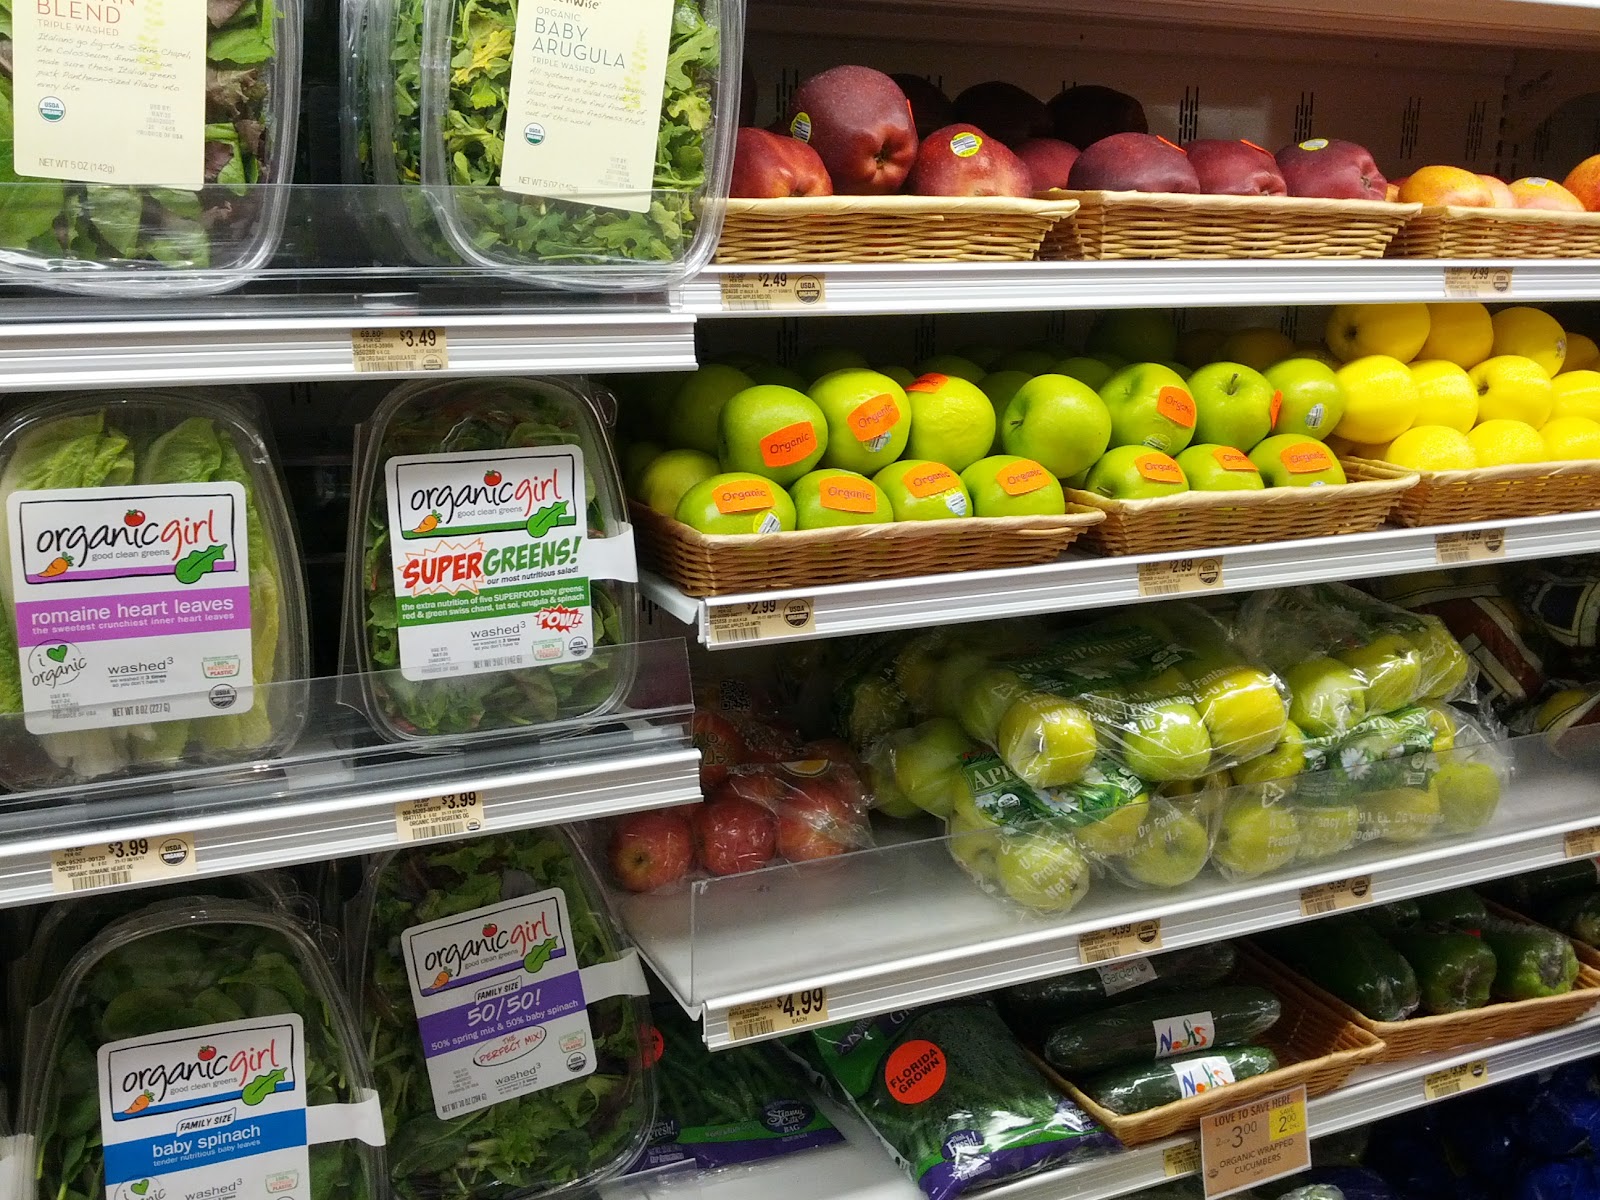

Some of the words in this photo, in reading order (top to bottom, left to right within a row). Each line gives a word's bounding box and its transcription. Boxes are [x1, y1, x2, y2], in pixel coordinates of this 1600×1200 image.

[37, 0, 121, 24] BLEND
[536, 6, 581, 22] ORGANIC
[37, 19, 71, 30] TRIPLE
[75, 24, 119, 36] WASHED
[534, 17, 588, 42] BABY
[37, 33, 73, 44] Italians
[76, 39, 88, 48] go
[129, 44, 158, 54] Sistine
[37, 45, 52, 53] the
[532, 36, 625, 69] ARUGULA
[88, 63, 113, 73] these
[117, 66, 147, 76] Italian
[150, 71, 177, 81] greens
[532, 55, 558, 68] TRIPLE
[561, 61, 596, 75] WASHED
[38, 157, 54, 167] NET
[55, 159, 69, 169] WT
[70, 160, 76, 170] 5
[77, 161, 89, 171] OZ
[90, 163, 115, 174] (142g)
[519, 176, 532, 185] NET
[532, 177, 543, 186] WT
[758, 272, 787, 288] $2.49
[400, 329, 436, 347] $3.49
[858, 403, 894, 429] Organic
[770, 432, 810, 455] Organic
[1290, 452, 1327, 465] Organic
[912, 470, 951, 487] Organic
[1007, 468, 1043, 486] Organic
[410, 468, 562, 524] organicgirl
[722, 488, 767, 502] Organic
[828, 486, 872, 501] Organic
[457, 510, 476, 519] good
[477, 507, 497, 516] clean
[499, 505, 523, 516] greens
[36, 509, 218, 568] organicgirl
[91, 552, 113, 562] good
[115, 551, 139, 560] clean
[141, 549, 170, 560] greens
[402, 551, 483, 589] SUPER
[486, 577, 500, 586] our
[501, 574, 521, 584] most
[521, 569, 556, 581] nutritious
[557, 566, 579, 577] salad!
[401, 603, 415, 611] the
[416, 601, 436, 610] extra
[437, 598, 470, 609] nutrition
[470, 597, 479, 605] of
[479, 595, 493, 604] five
[494, 590, 538, 601] SUPERFOOD
[539, 588, 558, 598] baby
[558, 585, 584, 596] greens:
[403, 611, 416, 620] red
[417, 611, 424, 619] &
[425, 609, 448, 620] green
[449, 607, 470, 616] swiss
[471, 604, 494, 614] chard,
[495, 602, 506, 611] tat
[506, 601, 520, 611] soi,
[521, 598, 549, 609] arugula
[549, 597, 557, 605] &
[557, 593, 585, 604] spinach
[747, 600, 776, 615] $2.99
[789, 605, 805, 613] USDA
[31, 606, 111, 626] romaine
[117, 600, 169, 618] heart
[174, 597, 234, 614] leaves
[537, 611, 583, 628] POW!
[32, 626, 49, 635] the
[51, 622, 96, 634] sweetest
[98, 618, 149, 630] crunchiest
[150, 616, 175, 626] inner
[177, 614, 203, 623] heart
[204, 612, 235, 621] leaves
[32, 657, 87, 689] organic
[112, 706, 124, 717] NET
[441, 792, 476, 809] $3.99
[431, 815, 462, 824] SUPERGREENS
[108, 838, 148, 858] $3.99
[165, 844, 182, 852] USDA
[68, 870, 88, 878] ORGANIC
[89, 867, 110, 875] ROMAINE
[424, 911, 552, 977] organicgirl
[464, 961, 480, 970] good
[480, 955, 497, 966] clean
[498, 949, 519, 960] greens
[1102, 965, 1139, 985] Garden
[477, 987, 502, 1001] FAMILY
[503, 982, 520, 993] SIZE
[467, 989, 541, 1027] 50/50!
[777, 987, 823, 1017] $4.99
[431, 1039, 451, 1051] 50%
[452, 1032, 479, 1046] spring
[480, 1025, 496, 1037] mix
[497, 1022, 505, 1031] &
[505, 1017, 525, 1028] 50%
[526, 1010, 546, 1023] baby
[547, 1000, 579, 1018] spinach
[792, 1016, 808, 1024] EACH
[478, 1043, 521, 1064] PERFECT
[525, 1030, 543, 1046] MIX!
[122, 1039, 279, 1103] organicgirl
[889, 1048, 938, 1089] FLORIDA
[898, 1057, 941, 1094] GROWN
[169, 1086, 189, 1096] good
[190, 1081, 211, 1091] clean
[212, 1077, 238, 1089] greens
[1214, 1113, 1235, 1127] LOVE
[1238, 1109, 1249, 1120] TO
[1250, 1102, 1270, 1117] SAVE
[1279, 1105, 1295, 1115] SAVE
[179, 1119, 212, 1132] FAMILY
[213, 1114, 233, 1126] SIZE
[152, 1139, 193, 1159] baby
[197, 1124, 261, 1152] spinach
[153, 1156, 178, 1168] tender
[180, 1148, 216, 1162] nutritious
[217, 1144, 236, 1156] baby
[237, 1138, 261, 1151] leaves
[1219, 1151, 1255, 1168] ORGANIC
[1257, 1138, 1294, 1156] WRAPPED
[1234, 1154, 1282, 1175] CUCUMBERS
